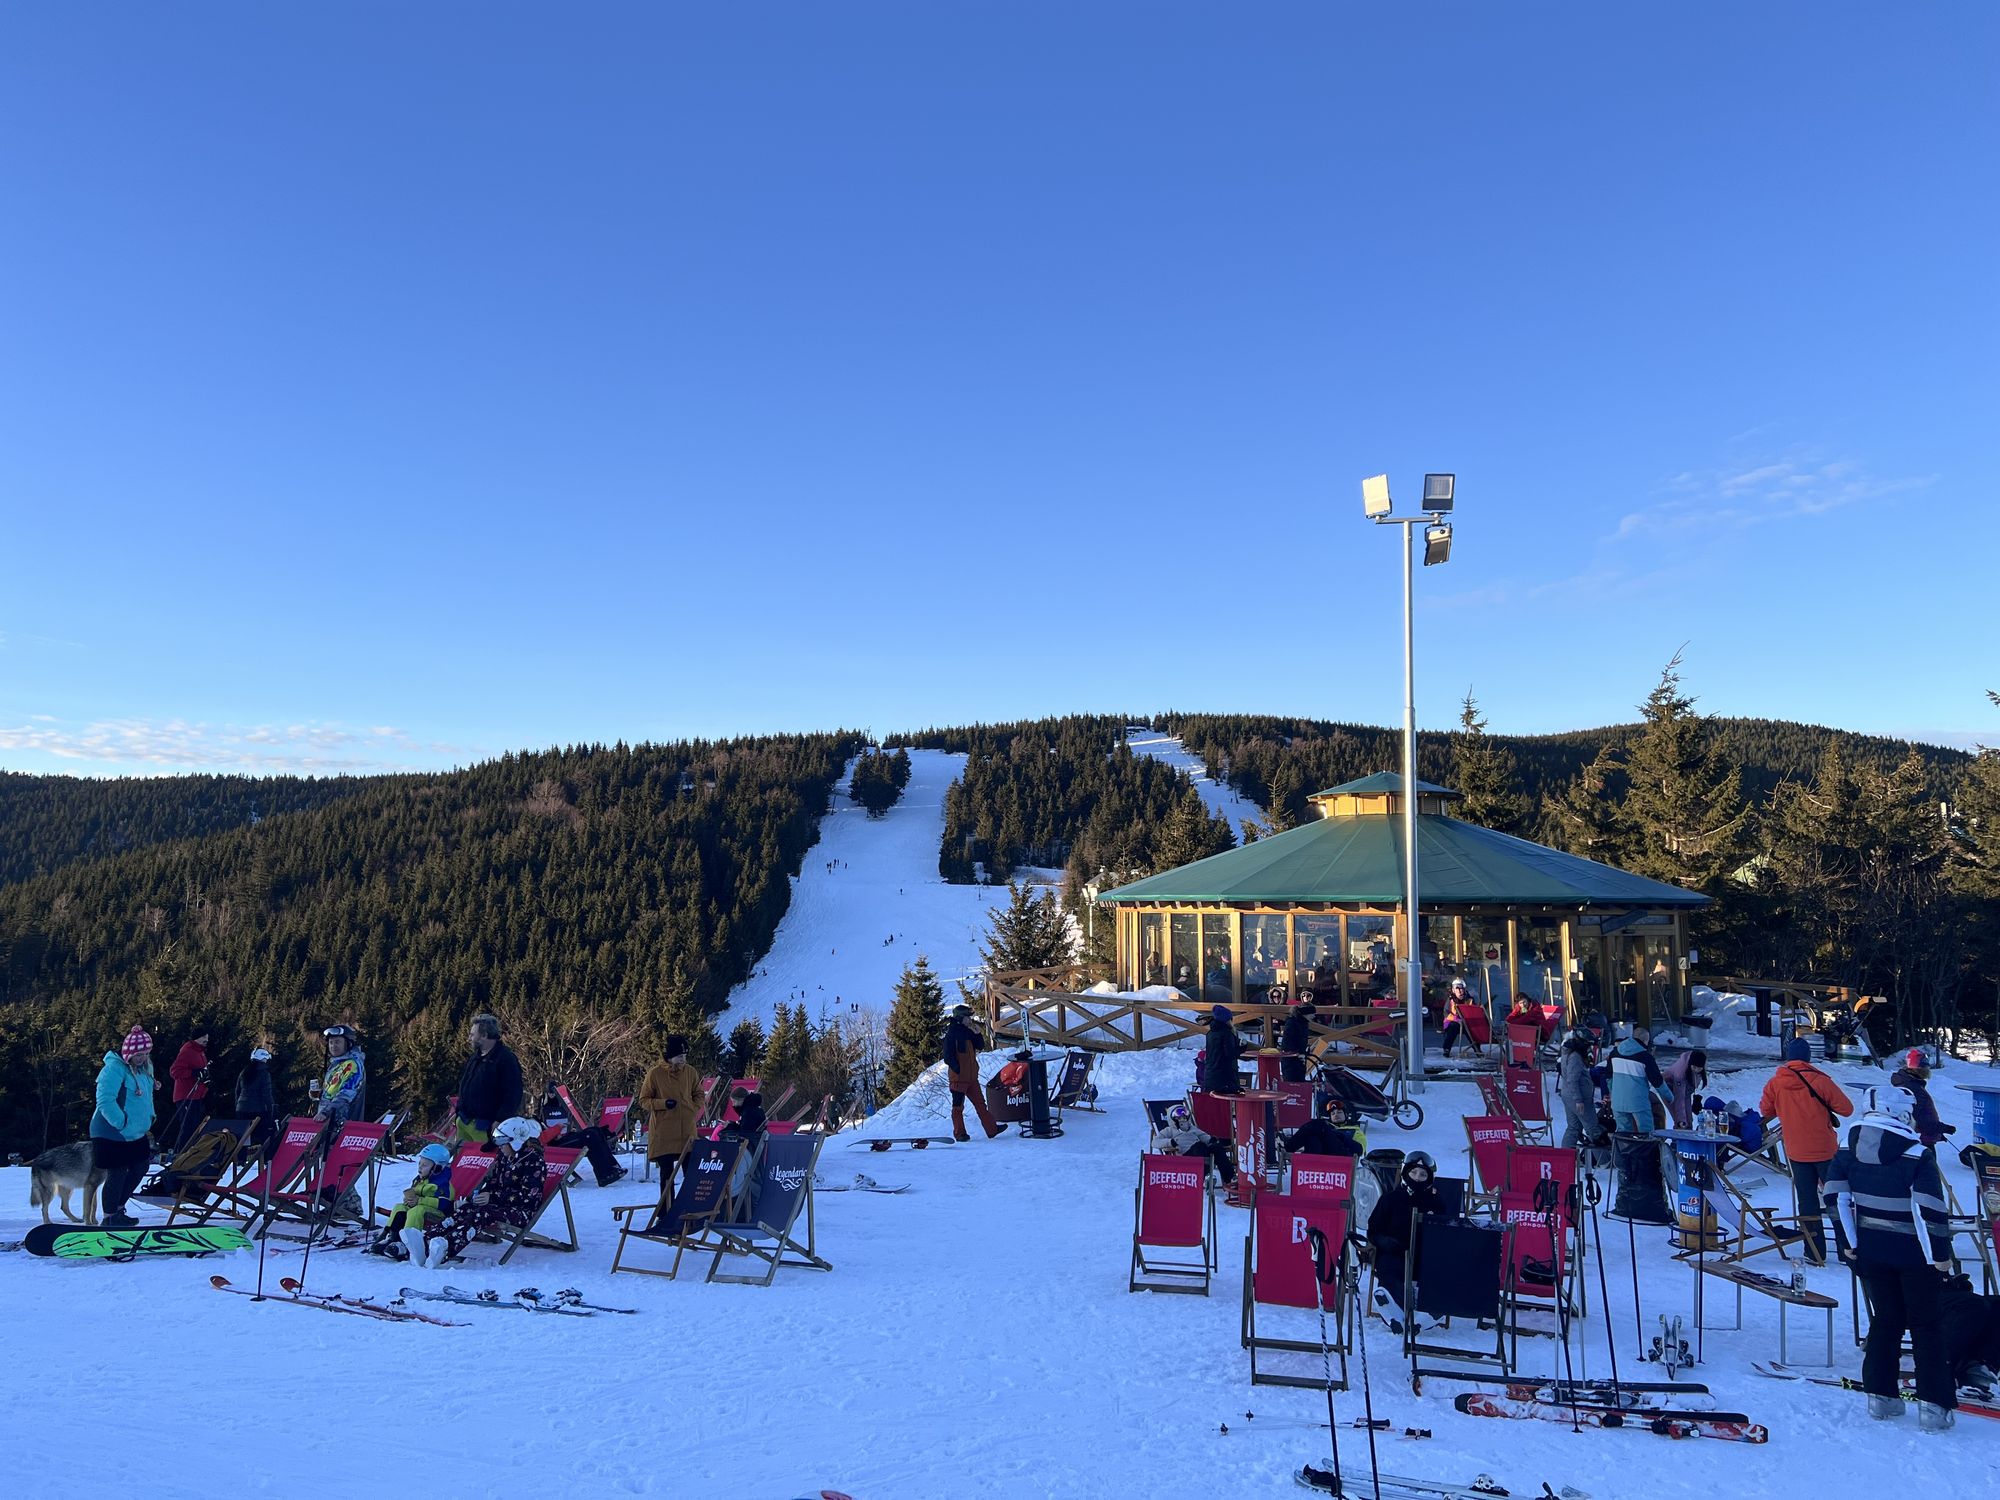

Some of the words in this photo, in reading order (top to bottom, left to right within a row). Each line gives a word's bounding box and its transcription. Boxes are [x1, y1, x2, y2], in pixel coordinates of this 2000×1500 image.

[1007, 1093, 1030, 1107] kofola
[340, 1135, 379, 1150] BEEFEATER
[1473, 1129, 1511, 1142] BEEFEATER
[457, 1155, 495, 1169] BEEFEATER
[698, 1158, 724, 1174] kofola
[1150, 1171, 1197, 1188] BEEFEATER
[1297, 1170, 1346, 1189] BEEFEATER
[1292, 1216, 1308, 1243] B
